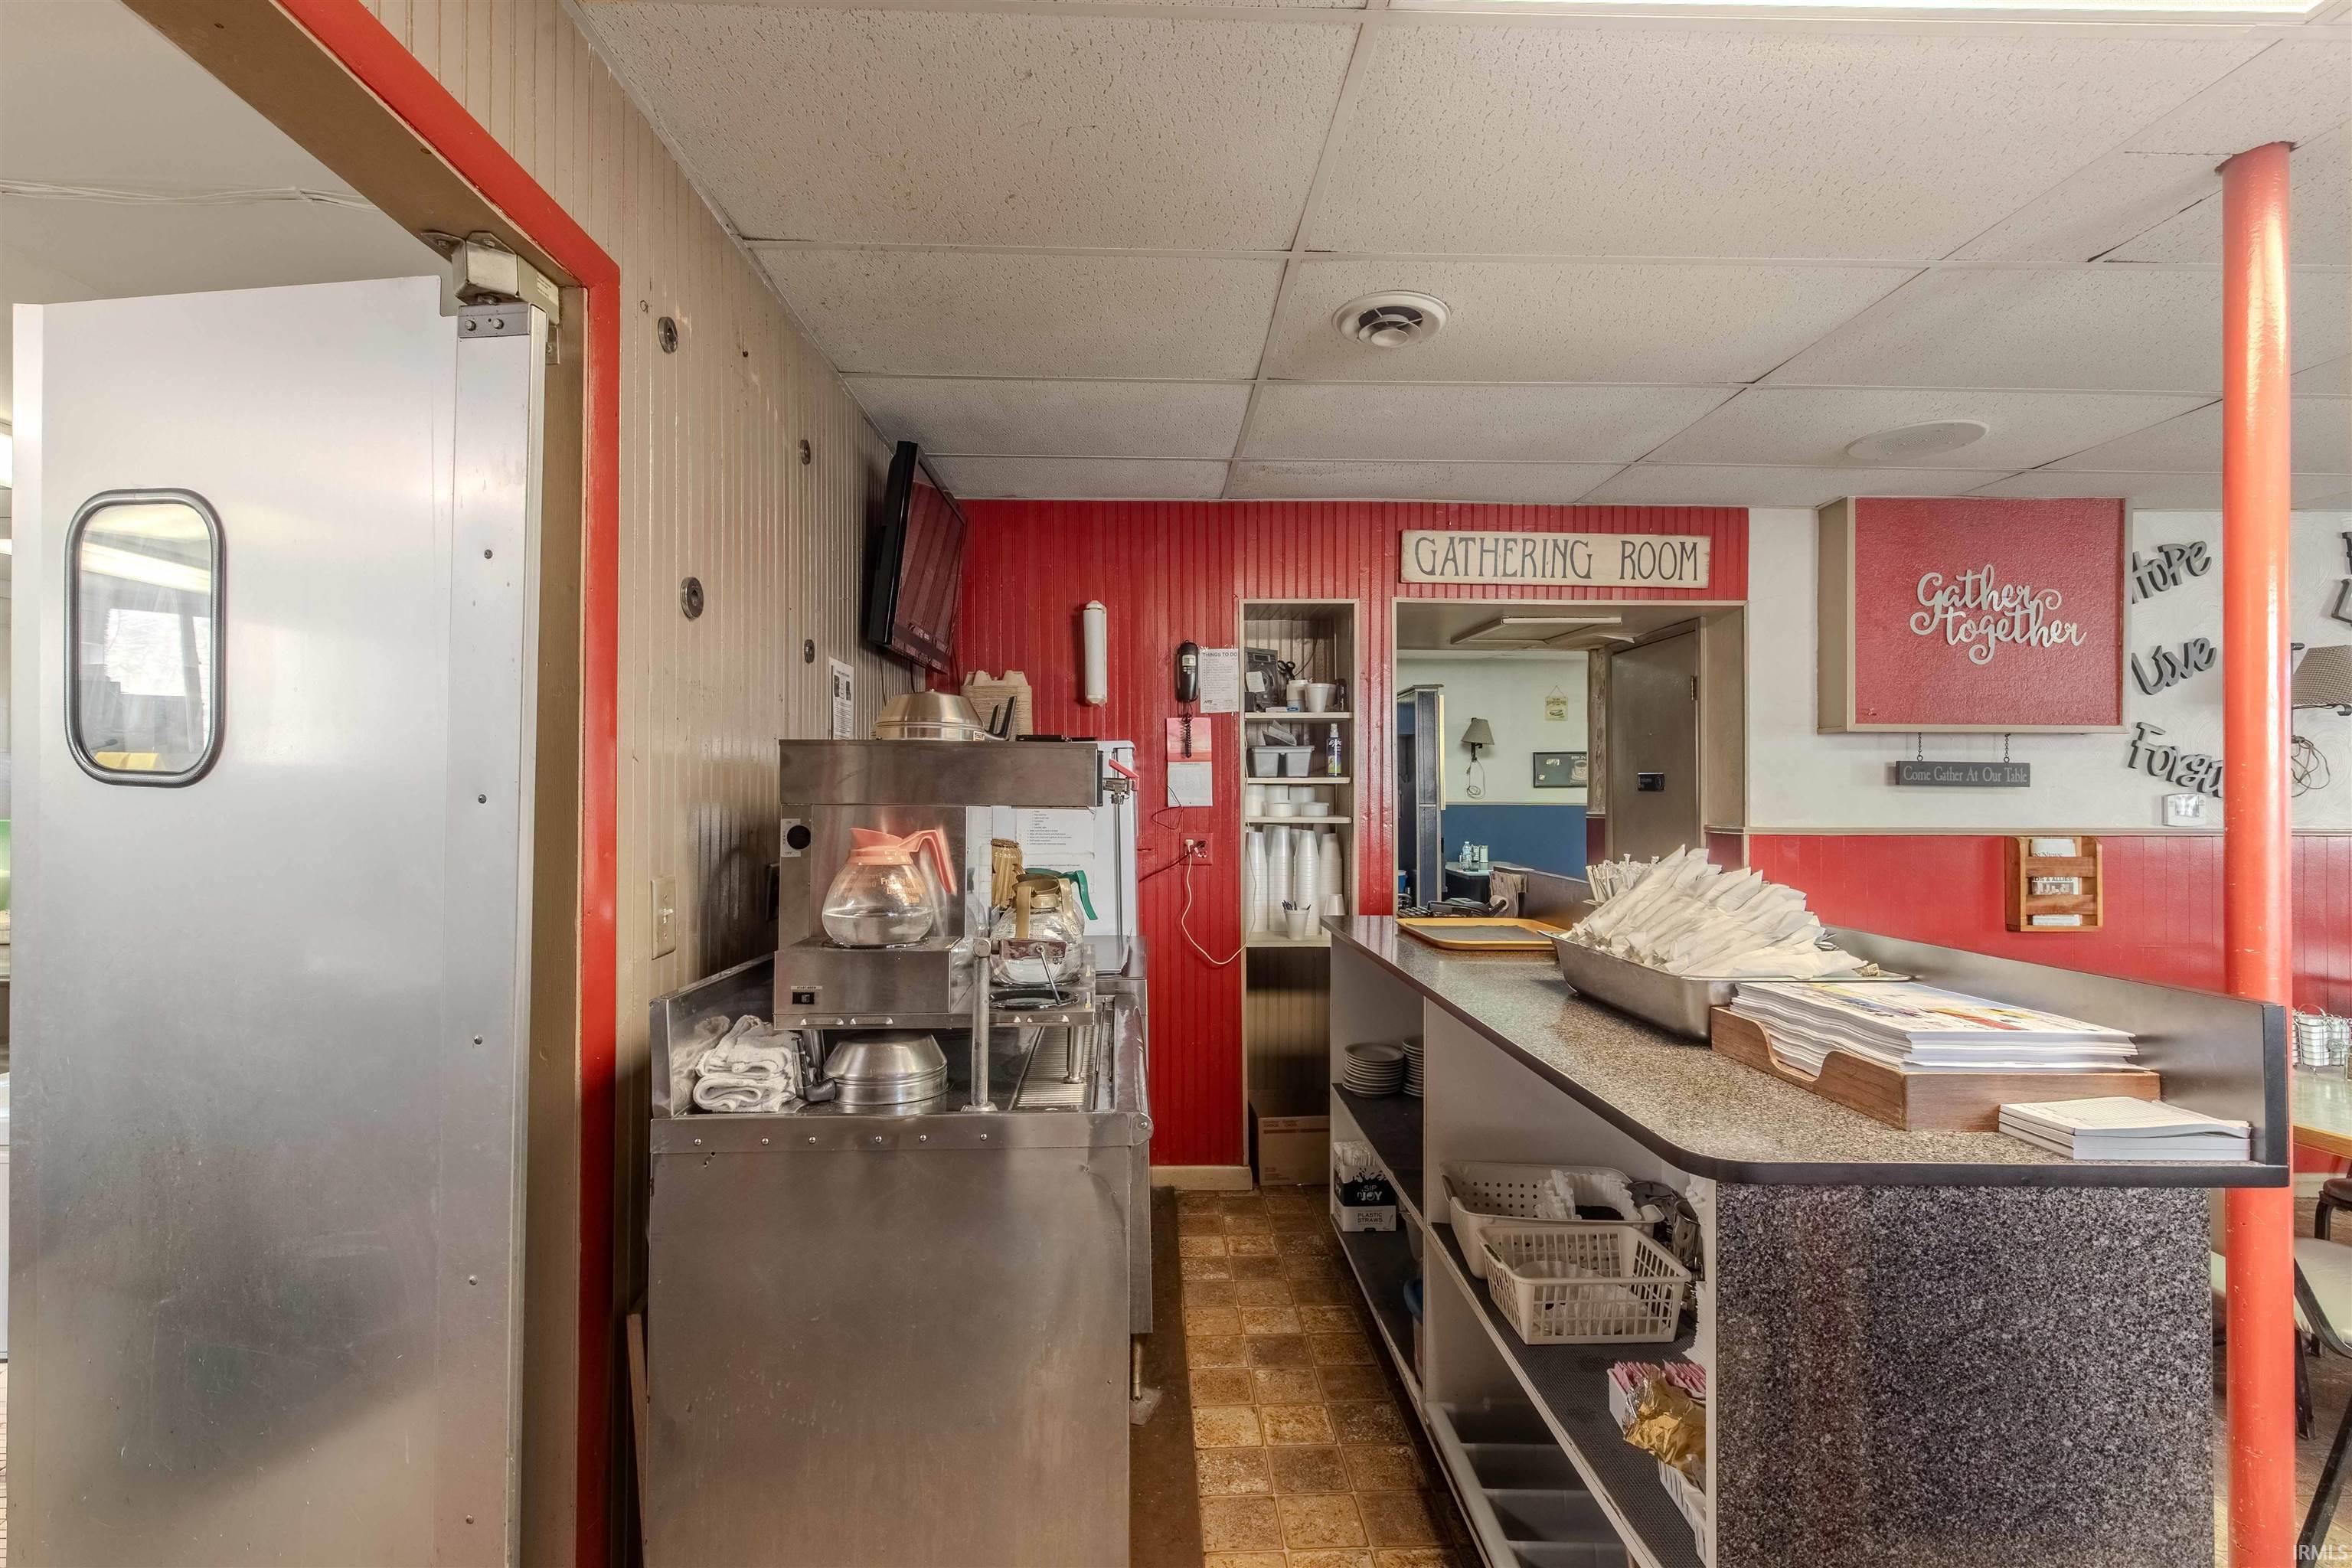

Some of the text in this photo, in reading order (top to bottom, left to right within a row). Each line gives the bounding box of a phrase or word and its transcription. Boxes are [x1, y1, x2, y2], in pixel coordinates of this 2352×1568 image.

[1414, 537, 1698, 581] GATHERING ROOM
[1909, 564, 2062, 635] Gather
[1940, 599, 2087, 665] together
[1903, 766, 2027, 782] Come Gather At Our Table
